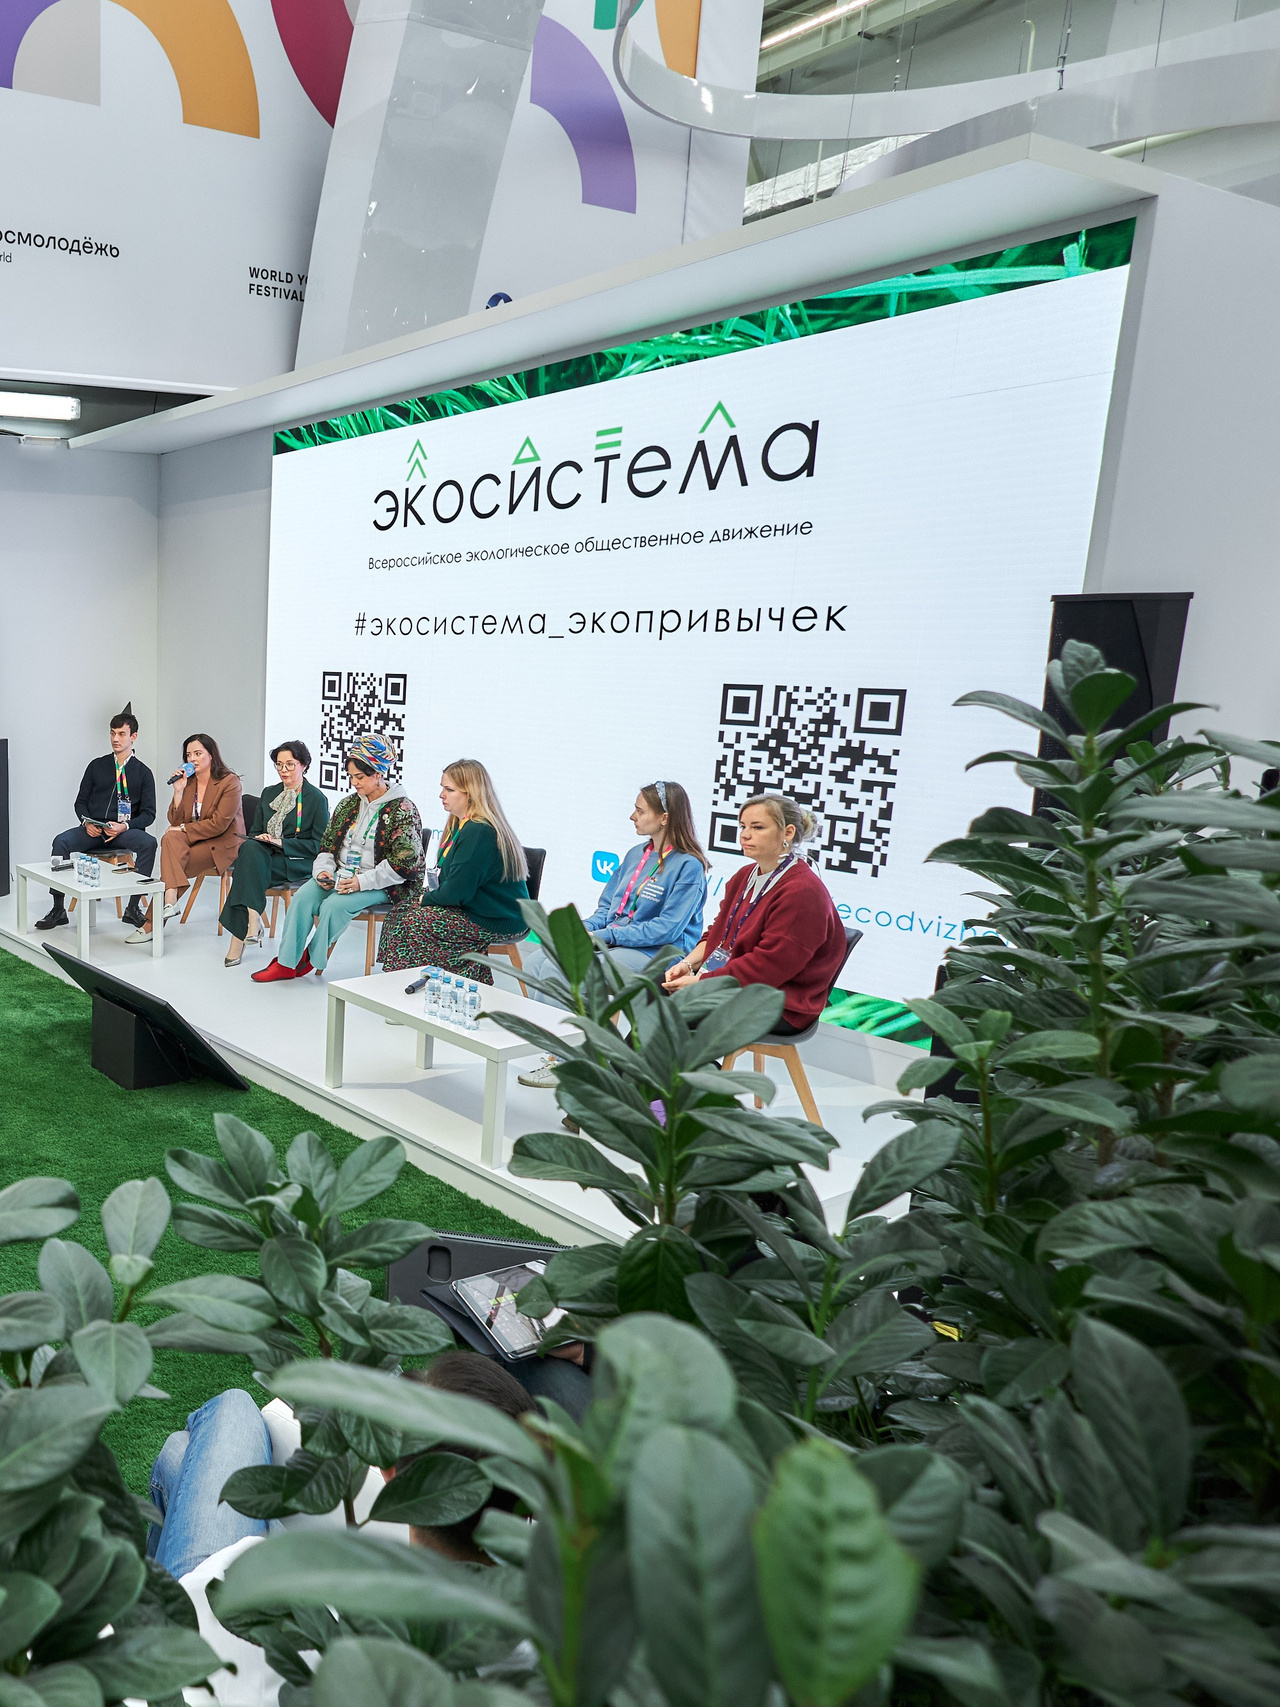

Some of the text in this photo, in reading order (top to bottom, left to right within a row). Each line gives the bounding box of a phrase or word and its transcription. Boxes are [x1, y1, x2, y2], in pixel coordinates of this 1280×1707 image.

[249, 266, 293, 284] WORLD
[248, 283, 305, 302] FESTIVAL
[368, 521, 813, 571] Всероссийское экологическое общественное движение
[354, 605, 848, 641] #экосистема_экопривычек
